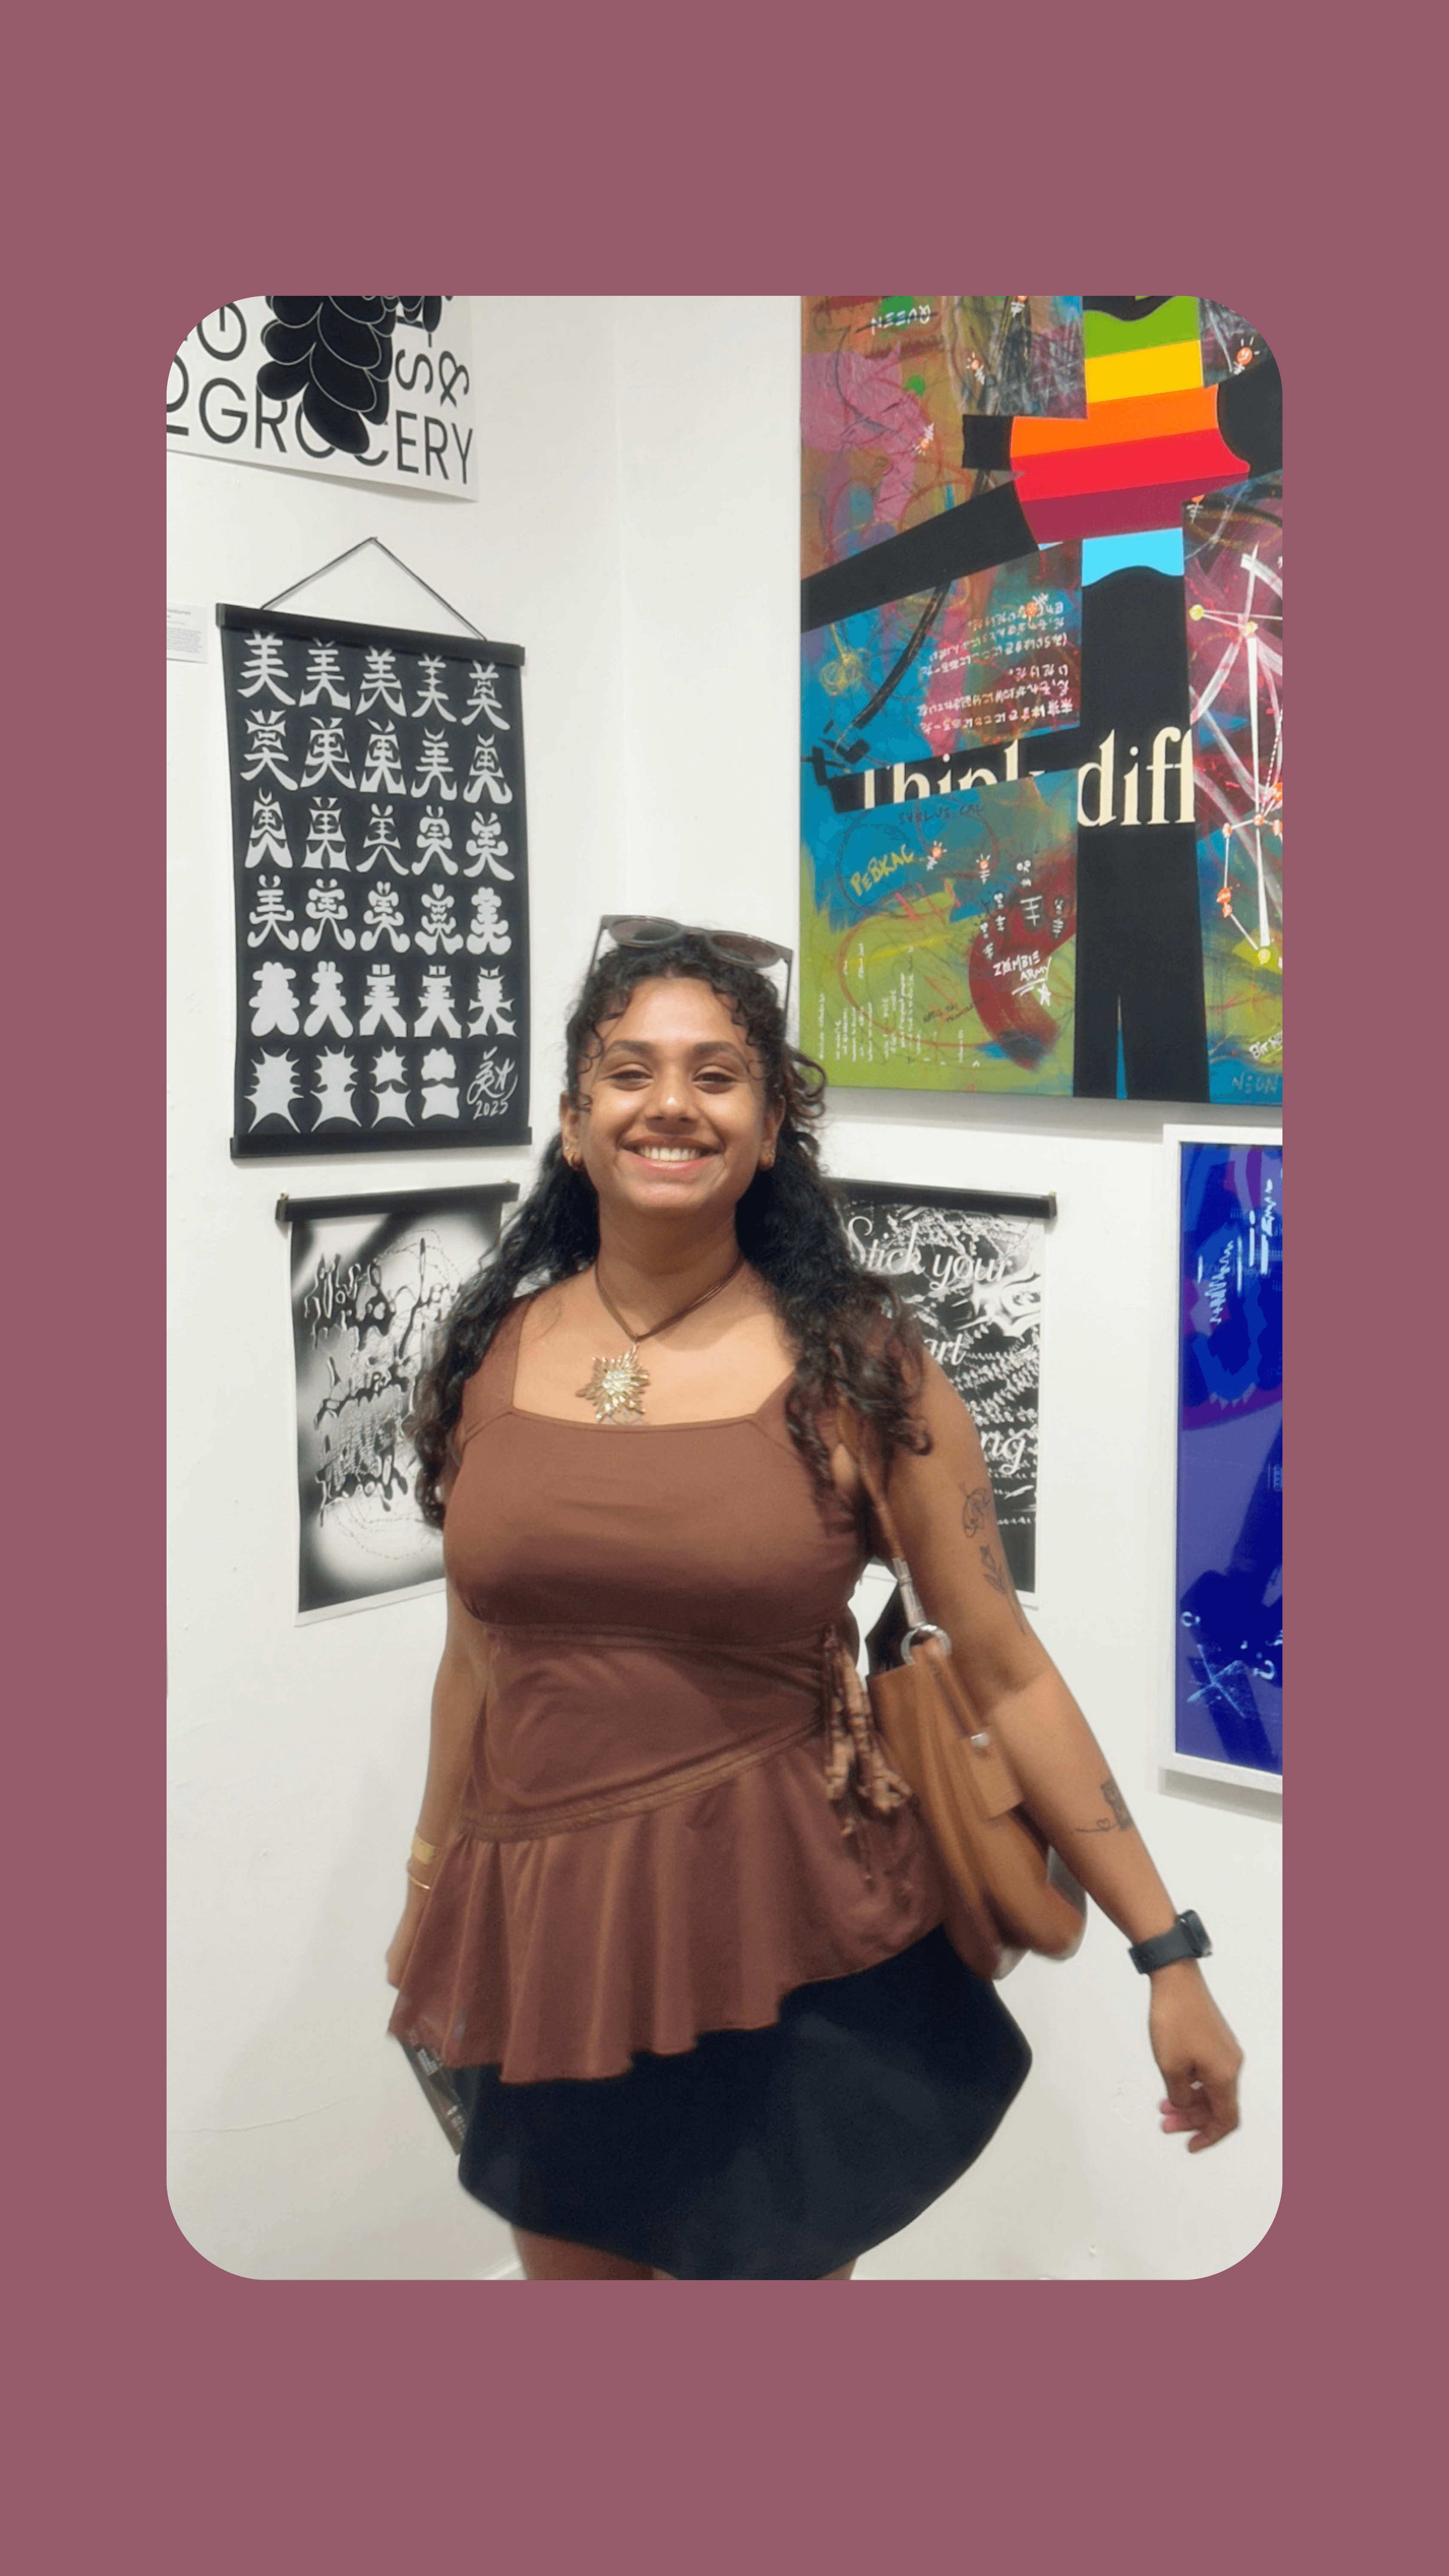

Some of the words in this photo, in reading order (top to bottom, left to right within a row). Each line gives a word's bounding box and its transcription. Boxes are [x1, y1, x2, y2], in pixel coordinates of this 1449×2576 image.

[199, 377, 473, 484] GROERY
[473, 1100, 508, 1120] 2025
[929, 1252, 1008, 1291] your
